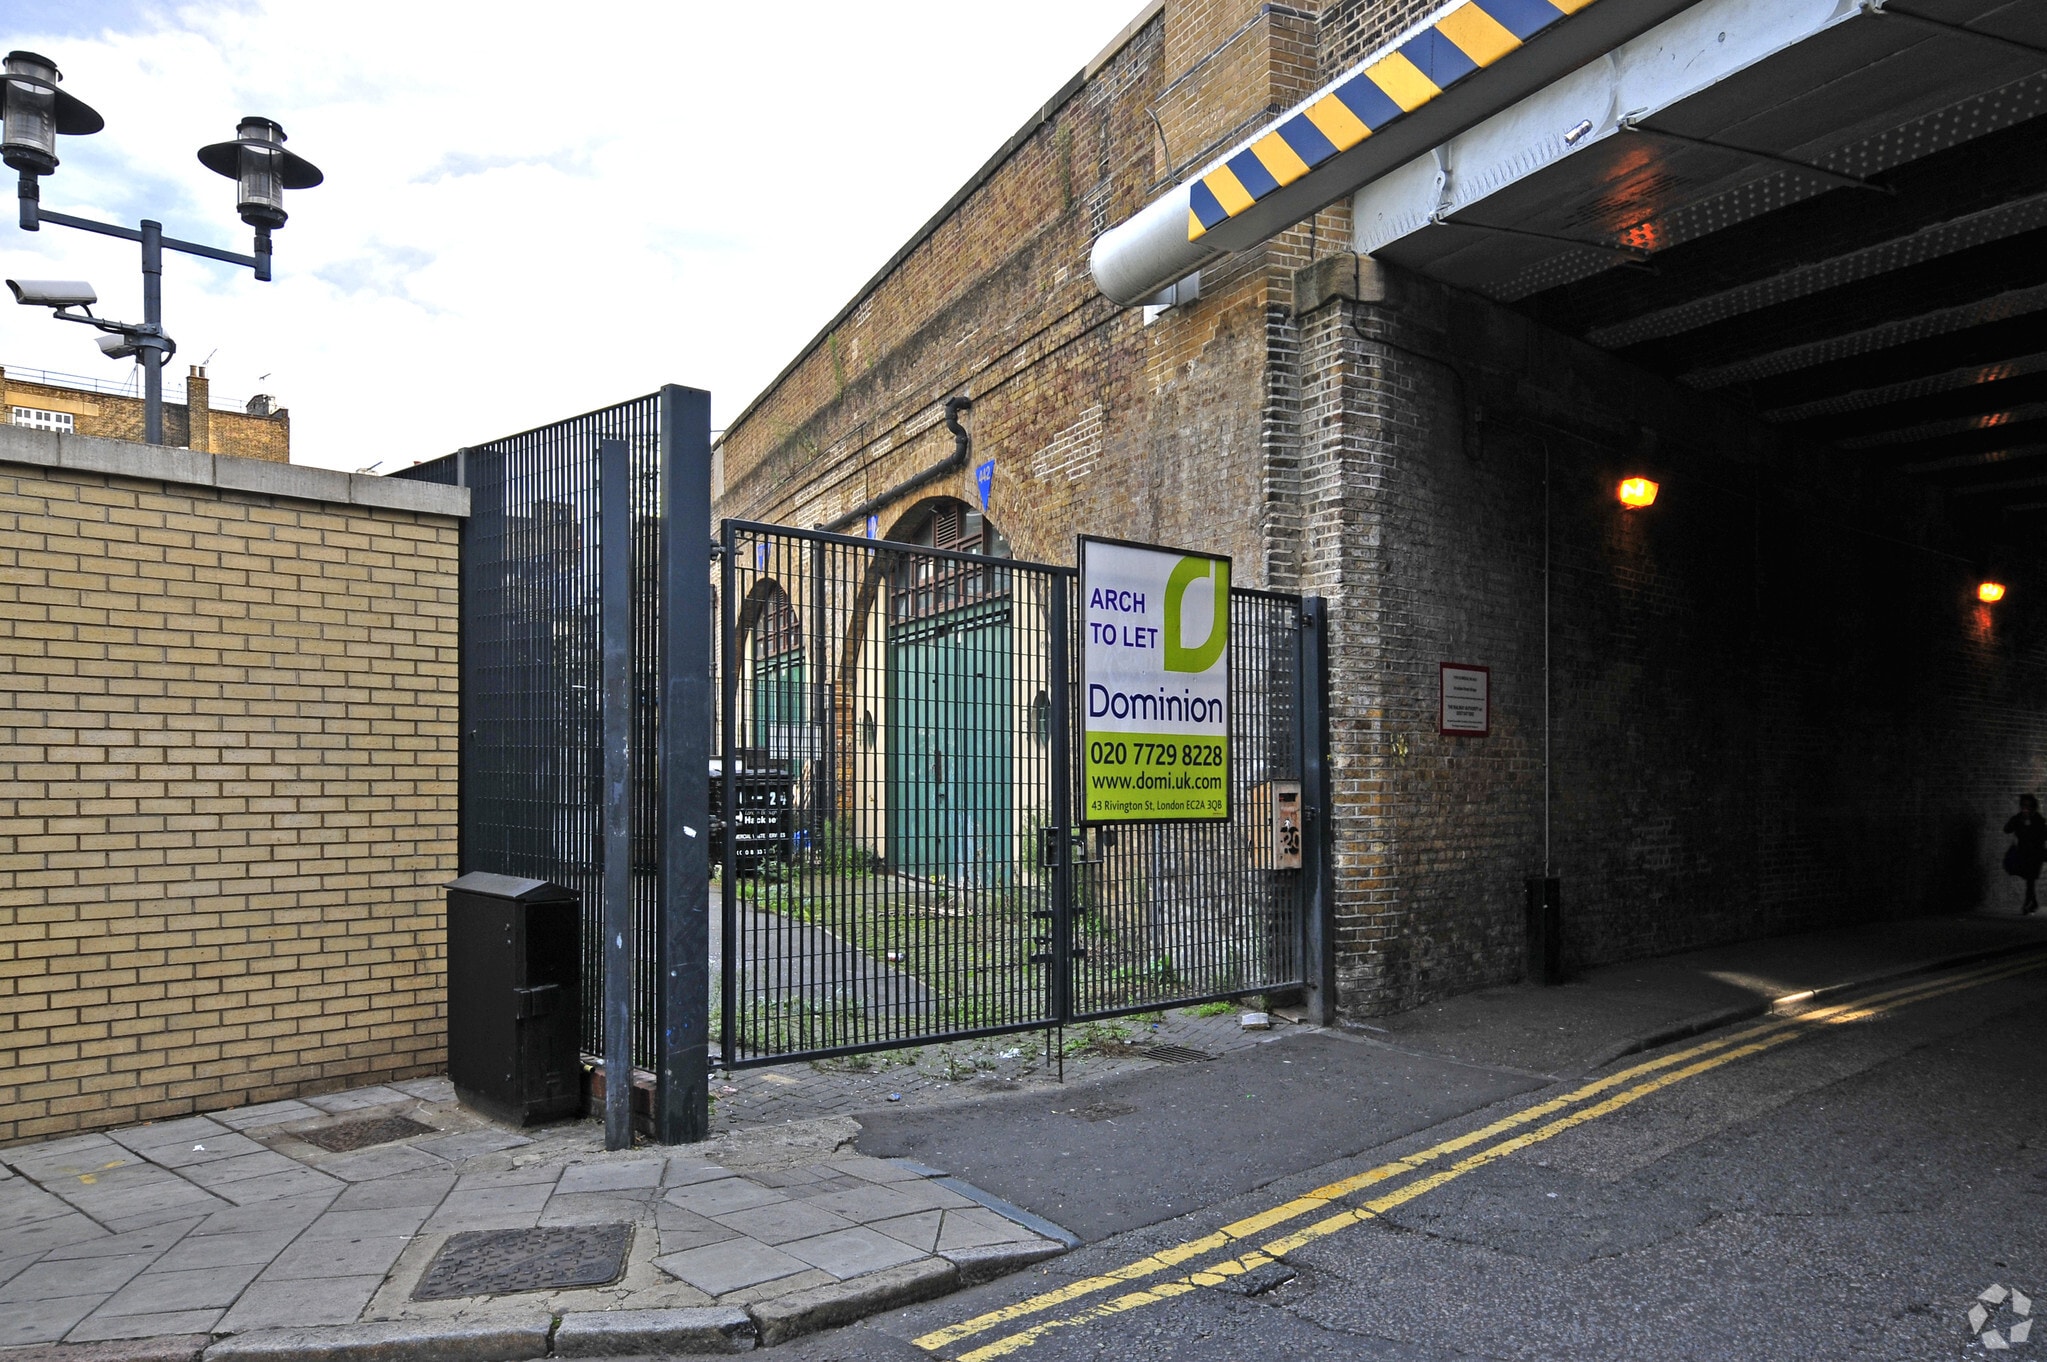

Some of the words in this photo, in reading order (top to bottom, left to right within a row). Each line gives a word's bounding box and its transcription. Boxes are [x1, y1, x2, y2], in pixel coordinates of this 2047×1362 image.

[1090, 587, 1146, 615] ARCH
[1090, 622, 1117, 646] TO
[1123, 625, 1159, 649] LET
[1089, 683, 1223, 724] Dominion
[1091, 741, 1127, 765] 020
[1133, 743, 1178, 766] 7729
[1182, 744, 1223, 767] 8228
[1092, 771, 1222, 790] www.domi.uk.com
[1091, 800, 1102, 811] 43
[1104, 800, 1143, 814] Rivington
[1145, 800, 1156, 812] St,
[1157, 799, 1185, 811] London
[1186, 799, 1206, 810] EC2A
[1207, 799, 1223, 812] 3QB
